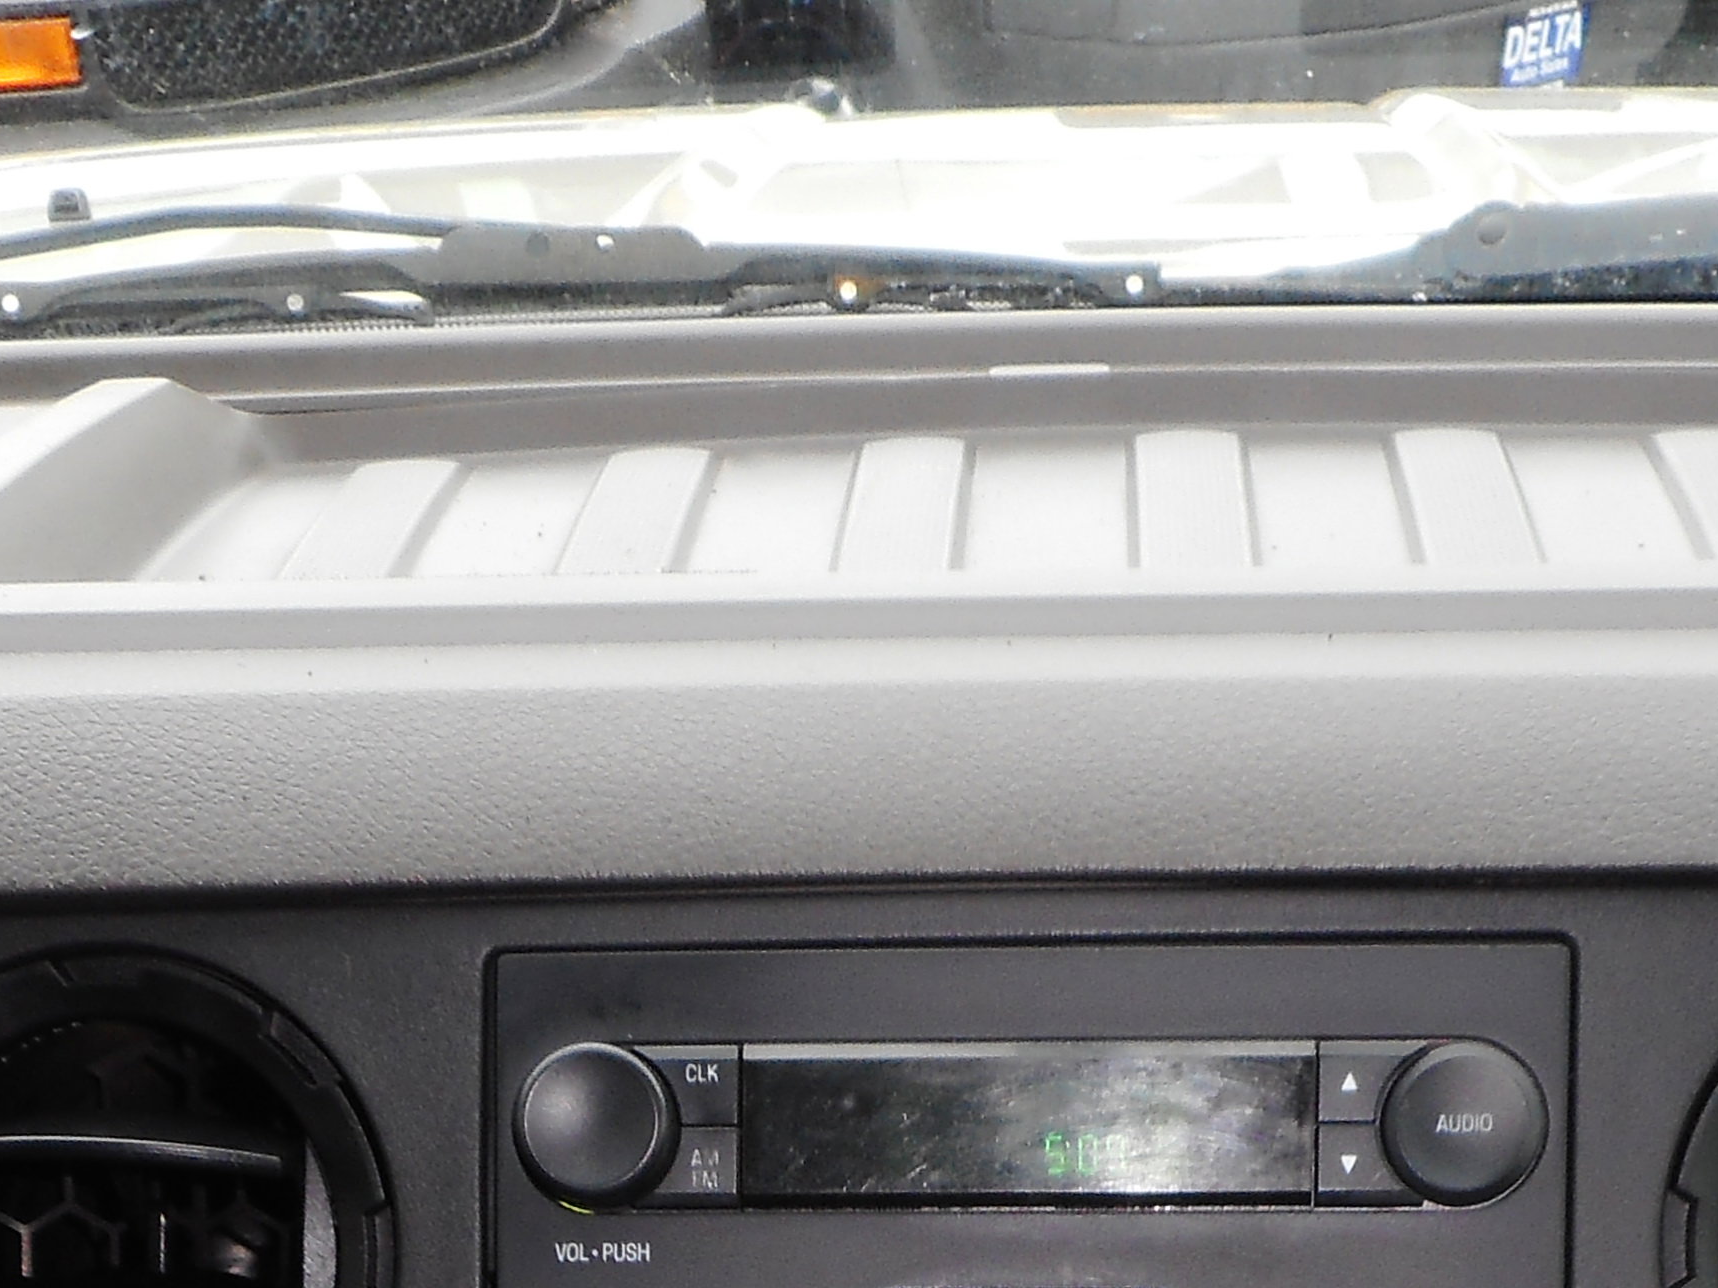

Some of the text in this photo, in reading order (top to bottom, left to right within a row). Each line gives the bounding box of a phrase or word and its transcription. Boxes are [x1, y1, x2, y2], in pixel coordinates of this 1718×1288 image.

[1502, 11, 1581, 69] DELTA
[685, 1063, 719, 1082] CLK
[1435, 1114, 1494, 1133] AUDIO
